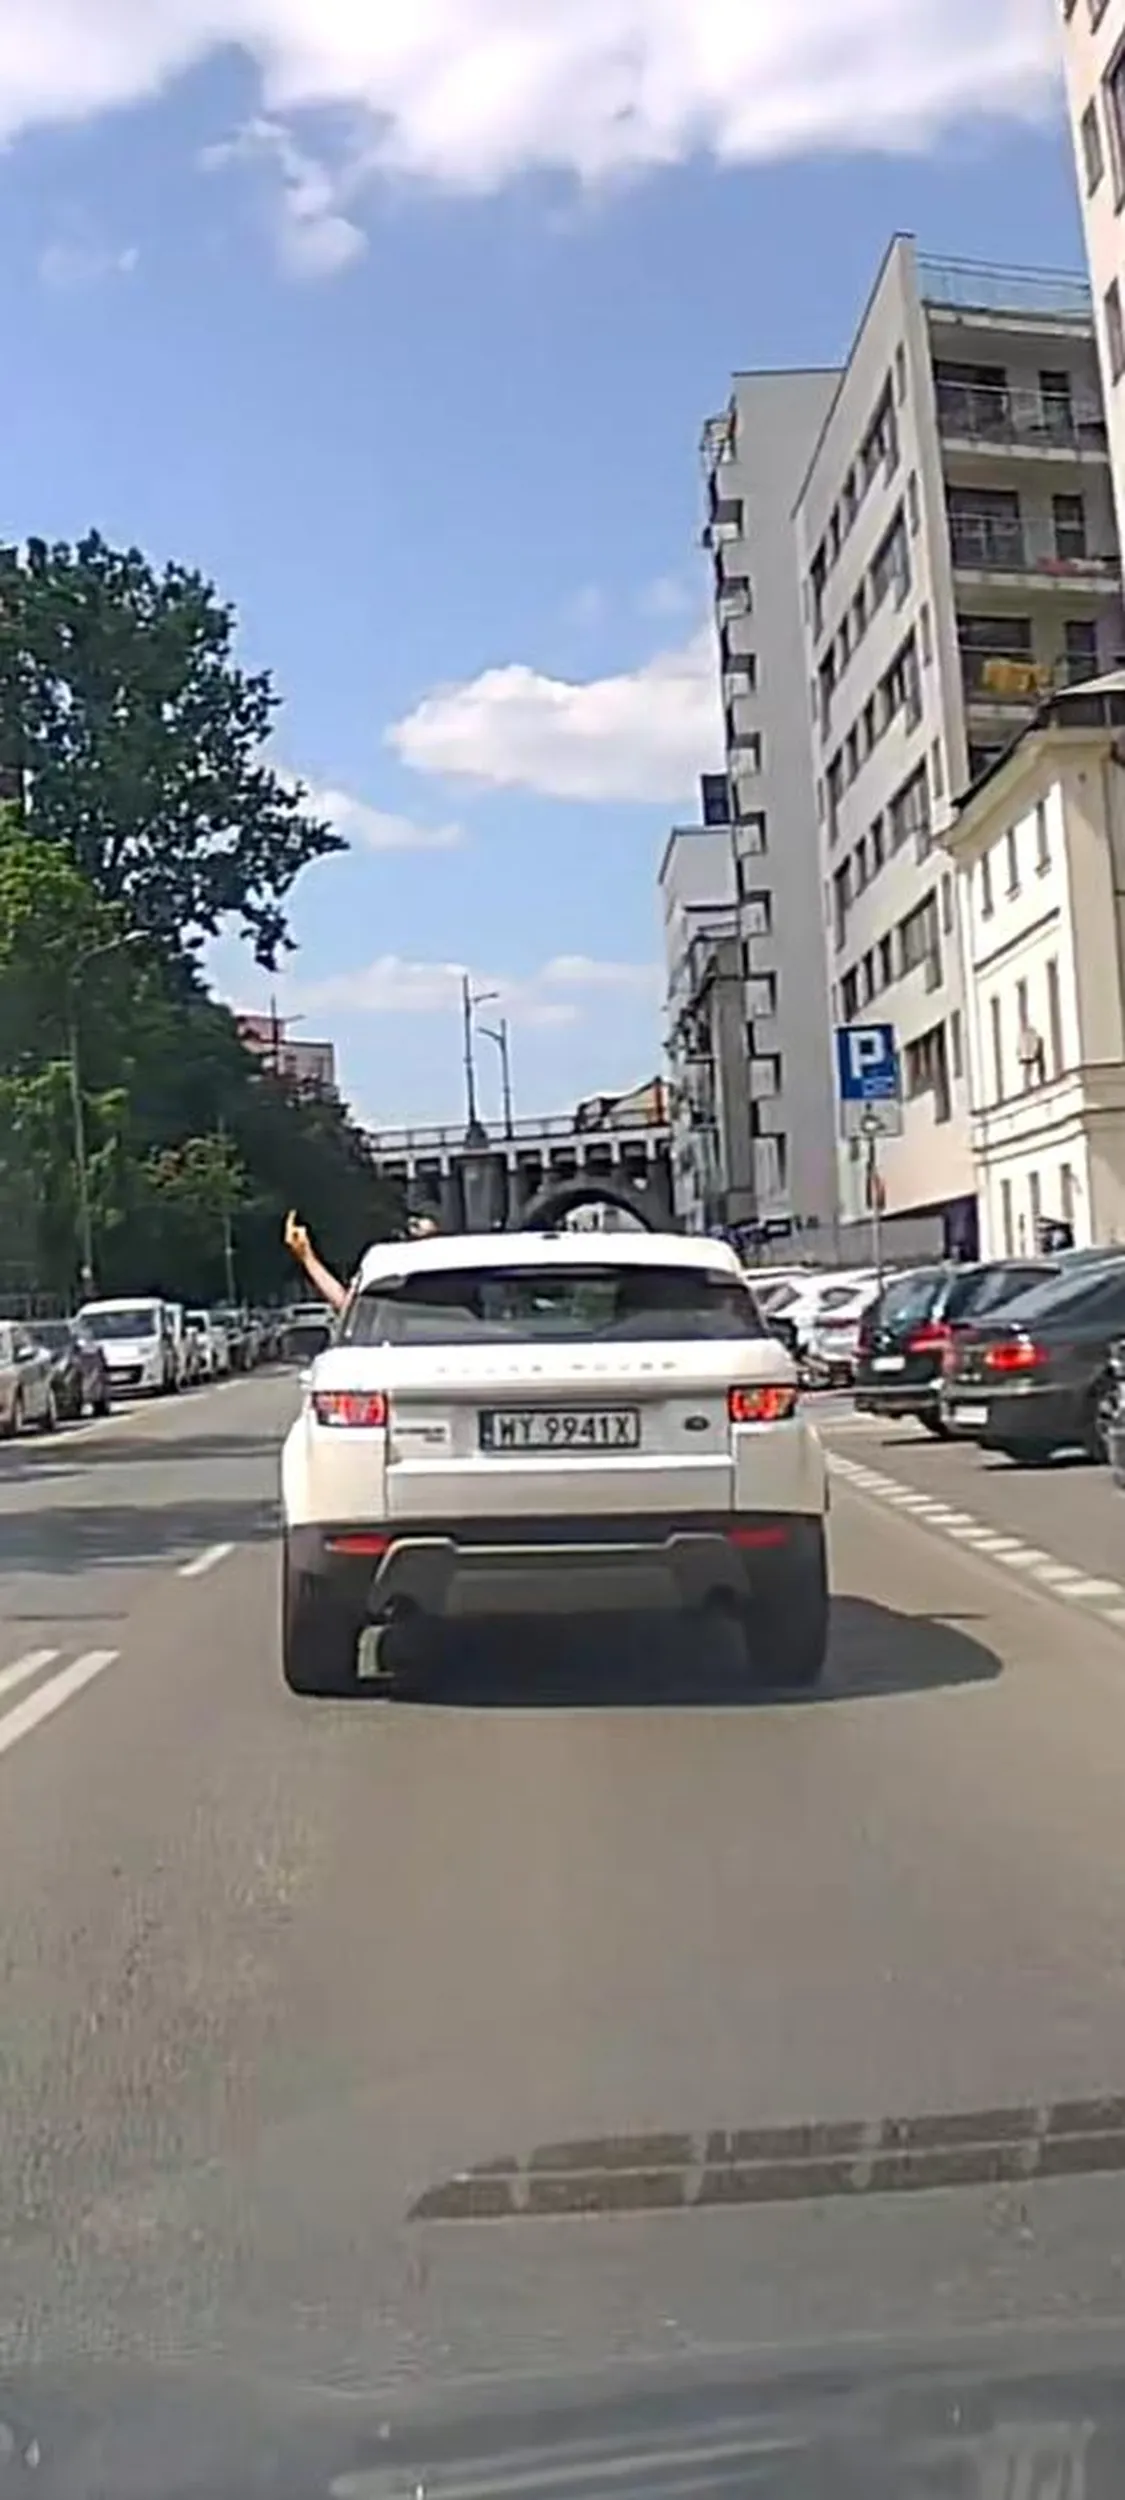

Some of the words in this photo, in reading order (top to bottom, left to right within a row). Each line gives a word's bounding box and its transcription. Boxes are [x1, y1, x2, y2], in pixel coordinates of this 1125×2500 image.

[849, 1031, 885, 1079] P
[500, 1417, 533, 1445] WY
[545, 1415, 629, 1444] 9941X
